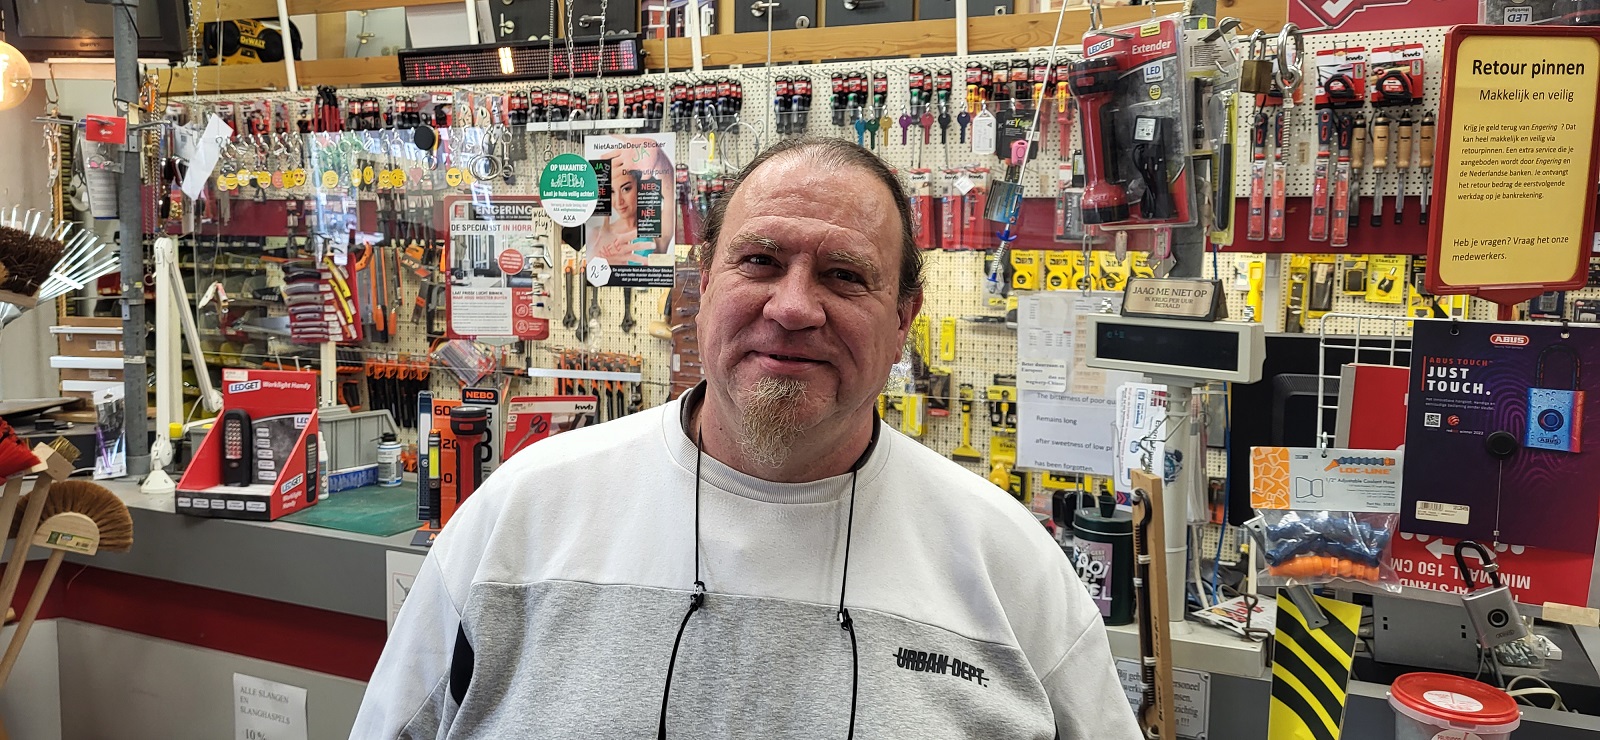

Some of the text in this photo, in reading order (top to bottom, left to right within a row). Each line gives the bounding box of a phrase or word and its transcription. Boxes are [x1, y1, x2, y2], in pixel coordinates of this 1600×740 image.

[1131, 39, 1172, 55] Extender
[1145, 65, 1160, 76] LED
[1472, 59, 1585, 79] Retour pinnen
[1479, 89, 1574, 103] Makkelijk en veilig
[1463, 124, 1478, 133] Krijg
[1478, 124, 1485, 132] je
[1486, 124, 1500, 132] geld
[1500, 124, 1518, 132] terug
[1531, 124, 1558, 132] Engering
[1490, 135, 1519, 144] makkelijk
[1530, 134, 1546, 143] veilig
[643, 141, 666, 149] Sticker
[1461, 146, 1504, 156] retourpinnen.
[1506, 146, 1518, 154] Een
[1567, 146, 1574, 154] je
[1460, 158, 1499, 167] aangeboden
[1536, 158, 1561, 166] Engering
[550, 164, 558, 172] OP
[1542, 168, 1569, 177] ontvangt
[1491, 180, 1513, 189] bedrag
[1523, 180, 1566, 188] eerstvolgende
[1458, 193, 1484, 201] werkdag
[1494, 192, 1501, 200] je
[1502, 192, 1544, 200] bankrekening.
[476, 206, 532, 215] ENGERING
[451, 224, 460, 232] DE
[512, 224, 532, 232] HORR
[1453, 236, 1569, 248] Heb je vragen? Vraag het onze
[1452, 252, 1507, 262] medewerkers.
[1132, 286, 1208, 298] JAAG ME NIET OP
[1494, 336, 1525, 344] ABUS
[1426, 366, 1470, 380] JUST
[230, 381, 311, 393] LEDGET Worklight Handy
[1426, 380, 1491, 396] TOUCH.
[466, 391, 495, 400] NEBO
[1050, 394, 1081, 402] bitterness
[1036, 415, 1078, 426] Remains long
[1052, 440, 1084, 448] sweetness
[1063, 463, 1094, 472] forgotten.
[282, 476, 302, 493] LEDGET
[1418, 561, 1445, 577] 150
[897, 647, 987, 687] URBAN DEPT.
[240, 686, 289, 704] ALLE SLANGEN
[240, 696, 249, 704] EN
[240, 705, 291, 725] SLANGHASPELS
